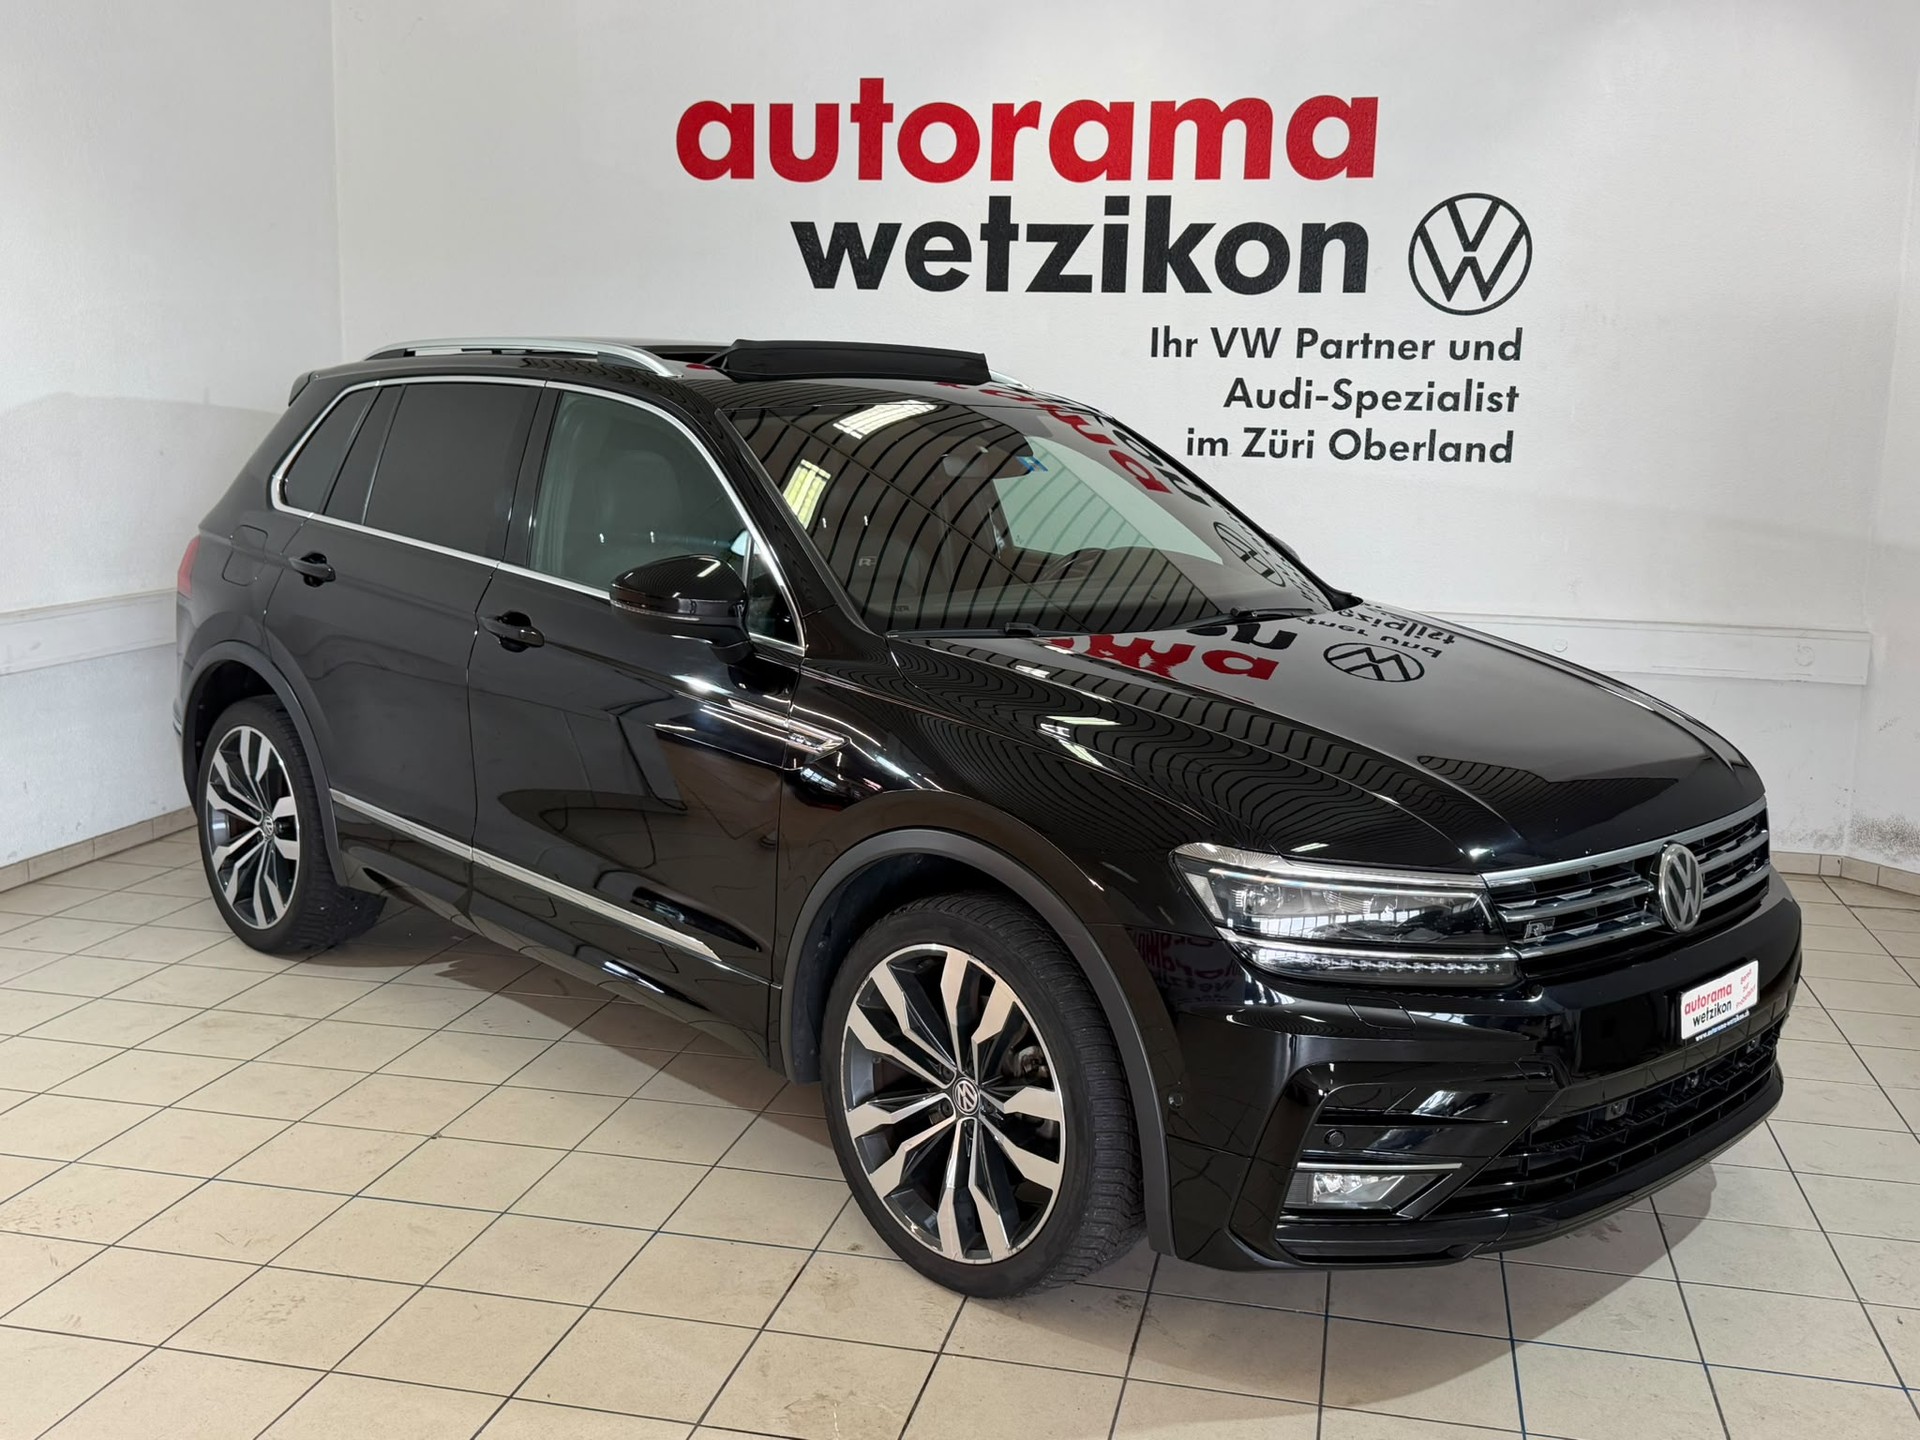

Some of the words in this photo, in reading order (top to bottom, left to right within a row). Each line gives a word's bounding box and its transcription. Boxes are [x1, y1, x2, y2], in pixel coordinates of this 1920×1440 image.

[676, 78, 1378, 183] autorama
[791, 196, 1368, 295] wetzikon
[1151, 326, 1197, 357] Ihr
[1211, 328, 1281, 358] VW
[1297, 328, 1435, 360] Partner
[1450, 328, 1522, 361] und
[1224, 377, 1519, 418] Audi-Spezialist
[1188, 428, 1228, 456] im
[1242, 428, 1314, 458] Züri
[1329, 428, 1513, 463] Oberland
[1684, 984, 1733, 1015] autorama
[1692, 1000, 1732, 1027] wetzikon
